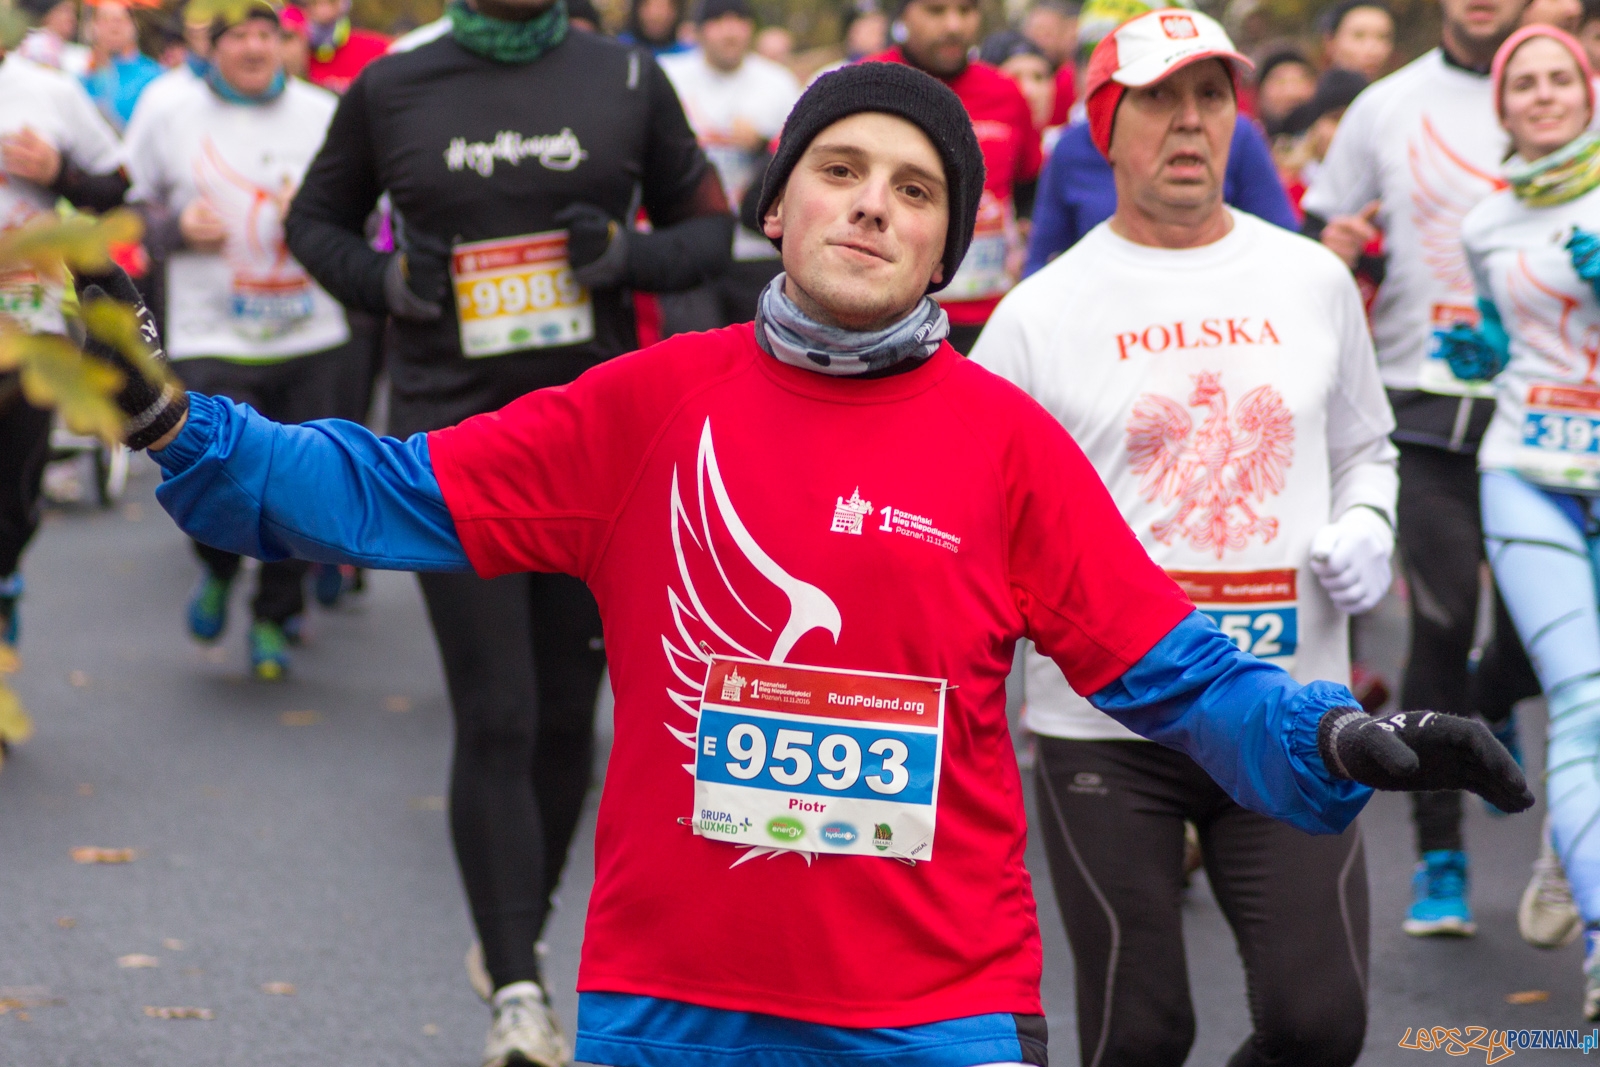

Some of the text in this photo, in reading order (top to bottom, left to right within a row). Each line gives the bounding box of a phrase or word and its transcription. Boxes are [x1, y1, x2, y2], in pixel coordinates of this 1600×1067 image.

[472, 272, 580, 316] 9989
[1115, 317, 1281, 361] POLSKA
[879, 506, 893, 532] 1
[893, 509, 932, 526] Poznański
[892, 516, 961, 544] Bieg Niepodległości
[926, 534, 958, 553] 11.11.2016
[1205, 613, 1284, 656] 52
[750, 679, 760, 699] 1
[759, 686, 771, 694] Bieg
[760, 680, 787, 689] Poznański
[827, 692, 925, 715] RunPoland.org
[703, 722, 910, 795] E 9593
[788, 798, 827, 813] Piotr
[701, 809, 732, 823] GRUPA
[700, 820, 738, 835] LUXMED
[772, 826, 802, 837] energy
